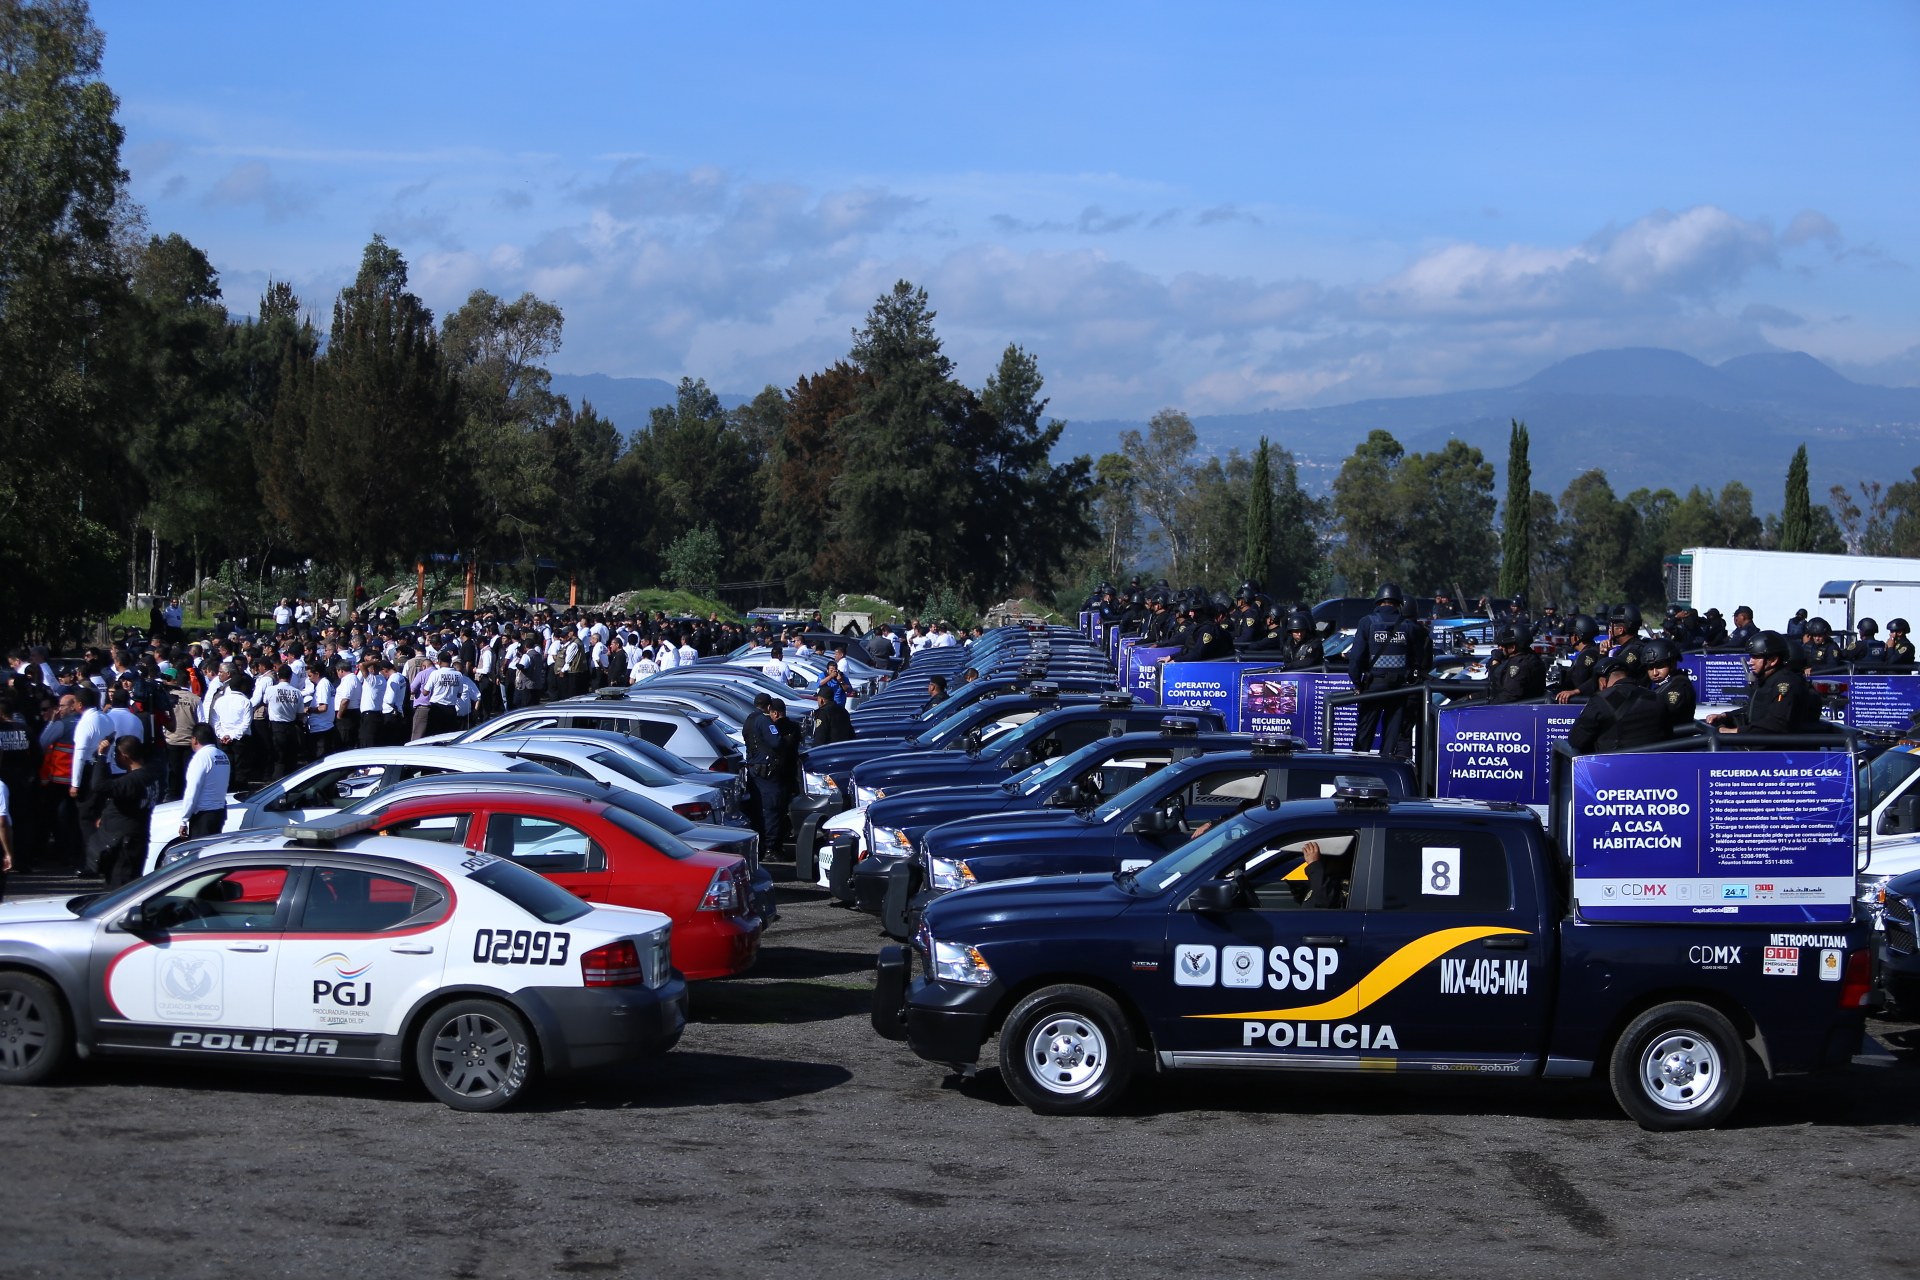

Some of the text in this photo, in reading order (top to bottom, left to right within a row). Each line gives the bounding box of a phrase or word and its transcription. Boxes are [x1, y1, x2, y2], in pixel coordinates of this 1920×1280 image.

[1456, 732, 1522, 741] OPERATIVO
[1446, 742, 1530, 753] CONTRA ROBO
[1467, 757, 1508, 766] A CASA
[1452, 768, 1523, 779] HABITACIÓN
[1596, 789, 1678, 801] OPERATIVO
[1584, 804, 1690, 816] CONTRA ROBO
[1611, 821, 1663, 833] A CASA
[1593, 834, 1682, 849] HABITACIÓN
[1430, 860, 1450, 891] 8
[1621, 884, 1666, 896] CDMX
[473, 929, 570, 966] 02993
[1770, 934, 1847, 948] METROPOLITANA
[1689, 946, 1741, 963] CDMX
[1766, 949, 1797, 959] 911
[1268, 946, 1339, 990] SSP
[1440, 959, 1528, 994] MX-405-M4
[313, 980, 372, 1006] PGJ
[1242, 1022, 1399, 1050] POLICIA
[170, 1032, 339, 1054] POLICÍA
[1432, 1064, 1519, 1072] ssp.cdmx.gob.mx
